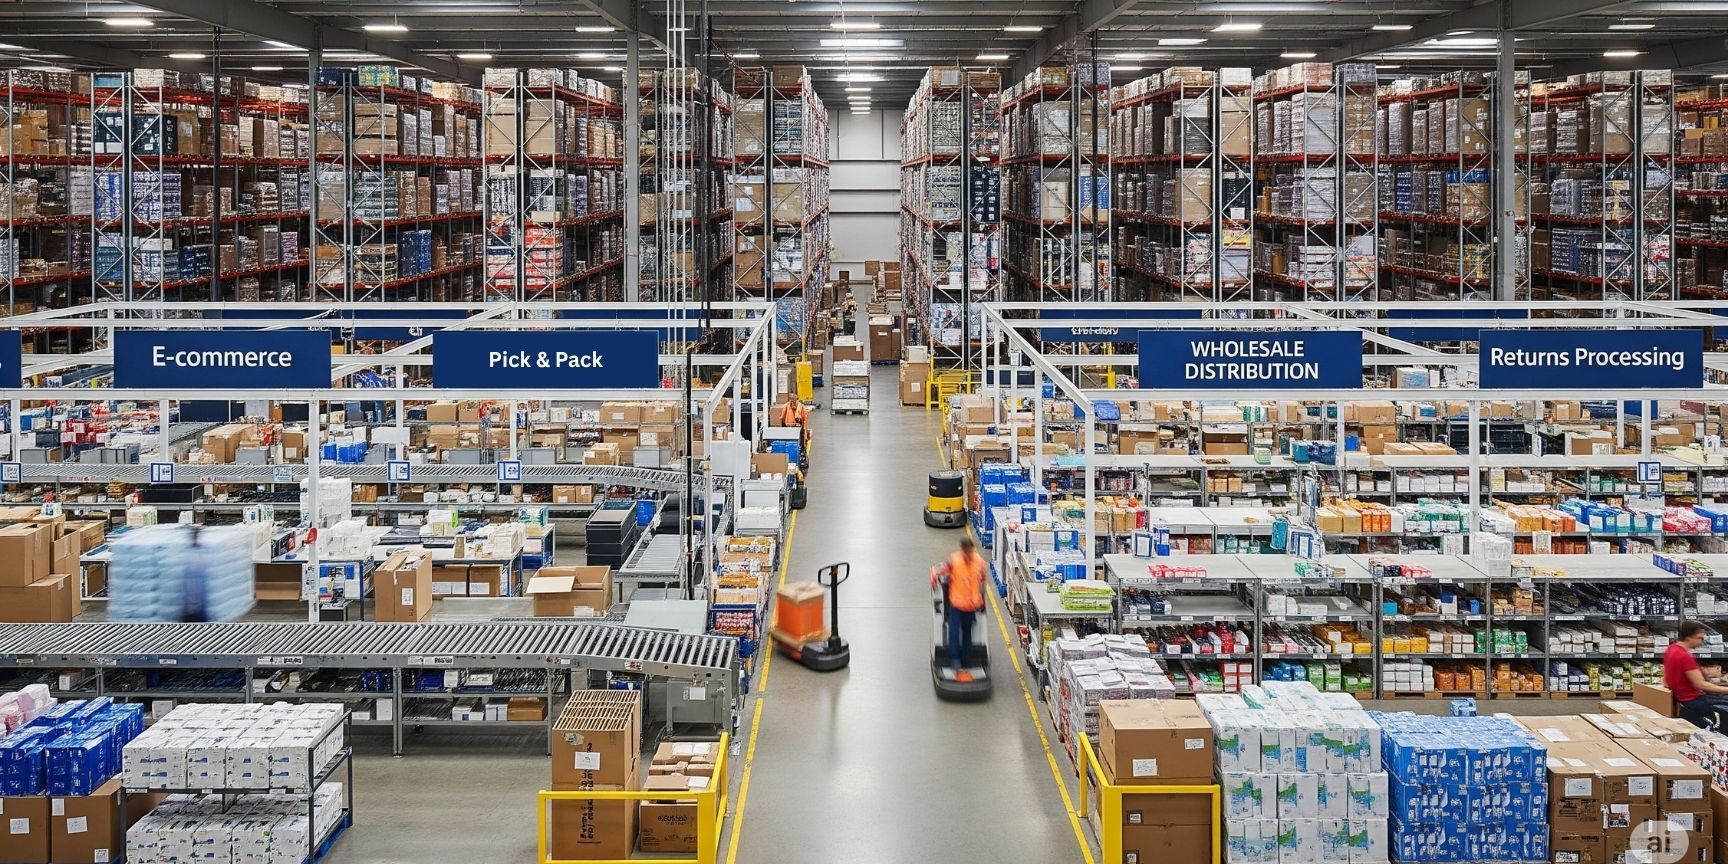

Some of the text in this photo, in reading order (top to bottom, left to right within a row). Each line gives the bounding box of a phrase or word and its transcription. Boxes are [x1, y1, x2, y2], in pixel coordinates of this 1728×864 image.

[152, 345, 292, 368] E-commerce
[1190, 340, 1306, 358] WHOLESALE
[1491, 346, 1685, 371] Returns Processing
[489, 350, 604, 368] Pick & Pack
[1185, 362, 1320, 381] DISTRIBUTION
